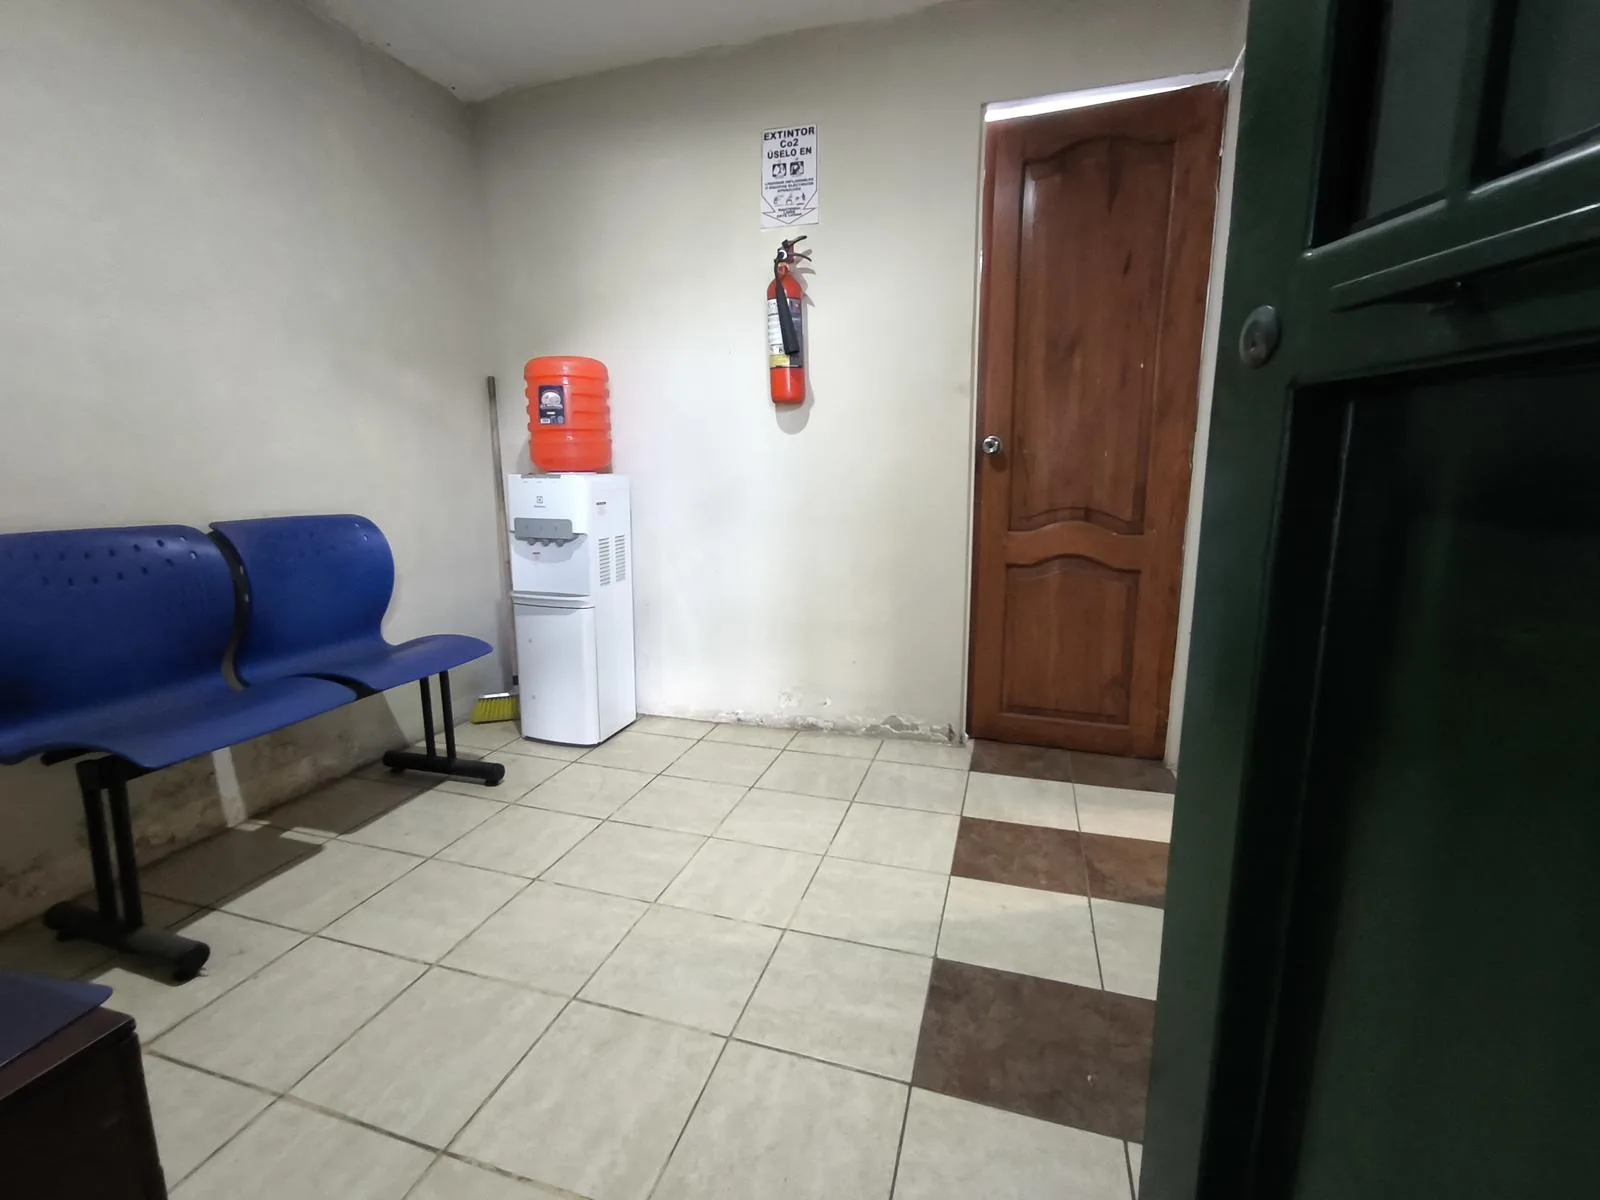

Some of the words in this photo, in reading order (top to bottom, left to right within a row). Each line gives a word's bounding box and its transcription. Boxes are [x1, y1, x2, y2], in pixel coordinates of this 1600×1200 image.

[764, 126, 815, 141] EXTINTOR
[780, 138, 799, 148] Co2
[800, 146, 812, 156] EN
